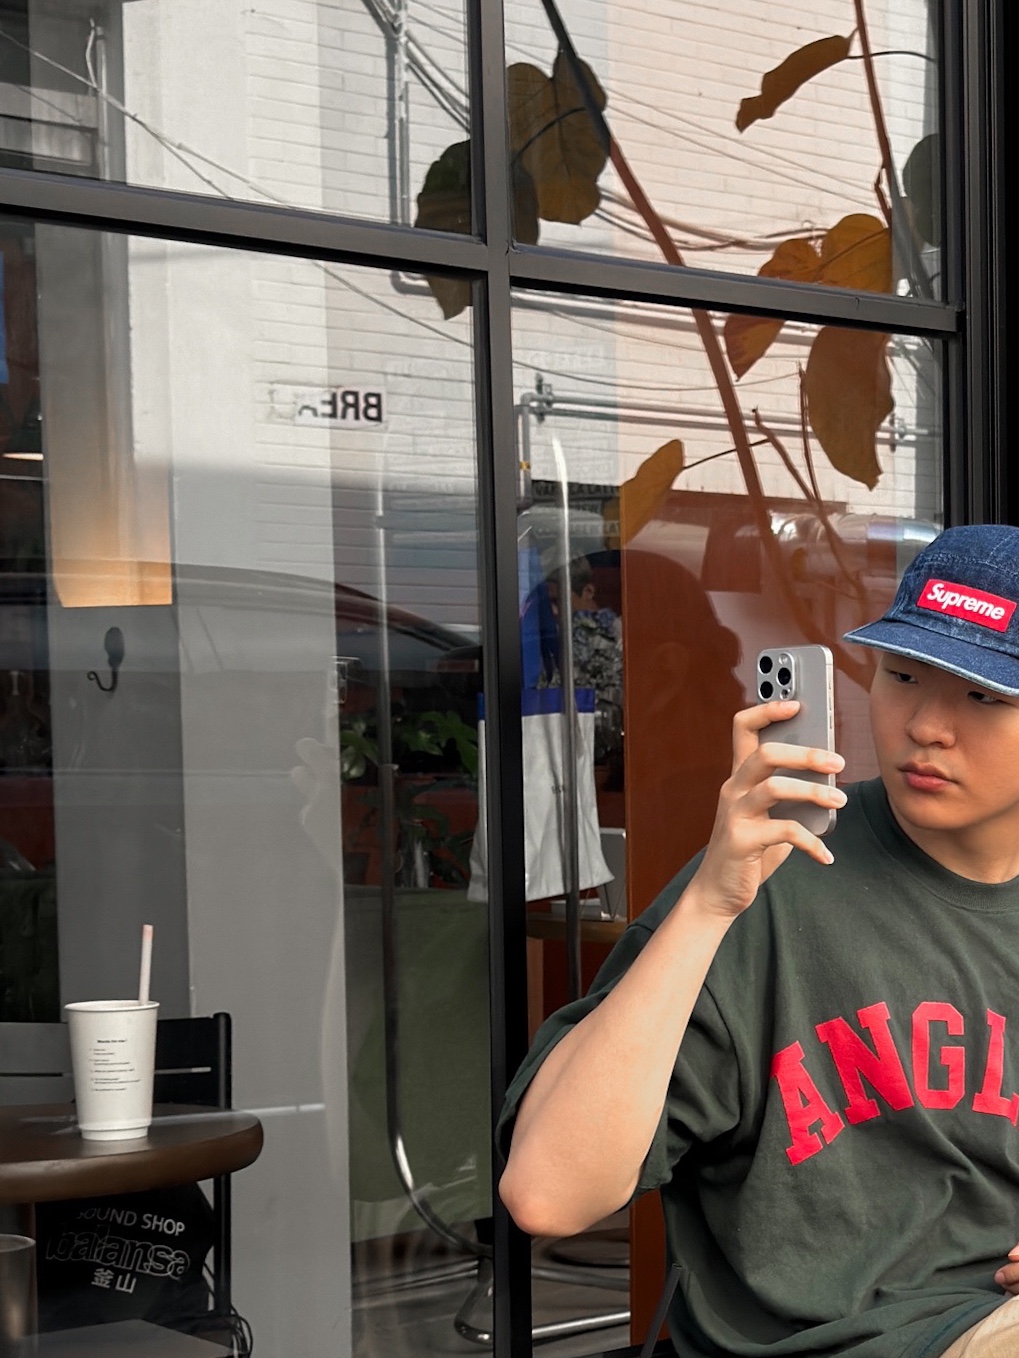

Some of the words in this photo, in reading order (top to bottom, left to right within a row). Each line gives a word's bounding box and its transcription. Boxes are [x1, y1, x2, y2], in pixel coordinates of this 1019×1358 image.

[926, 583, 1005, 620] Supreme
[140, 1213, 186, 1237] SHOP
[91, 1267, 138, 1295] 釜山
